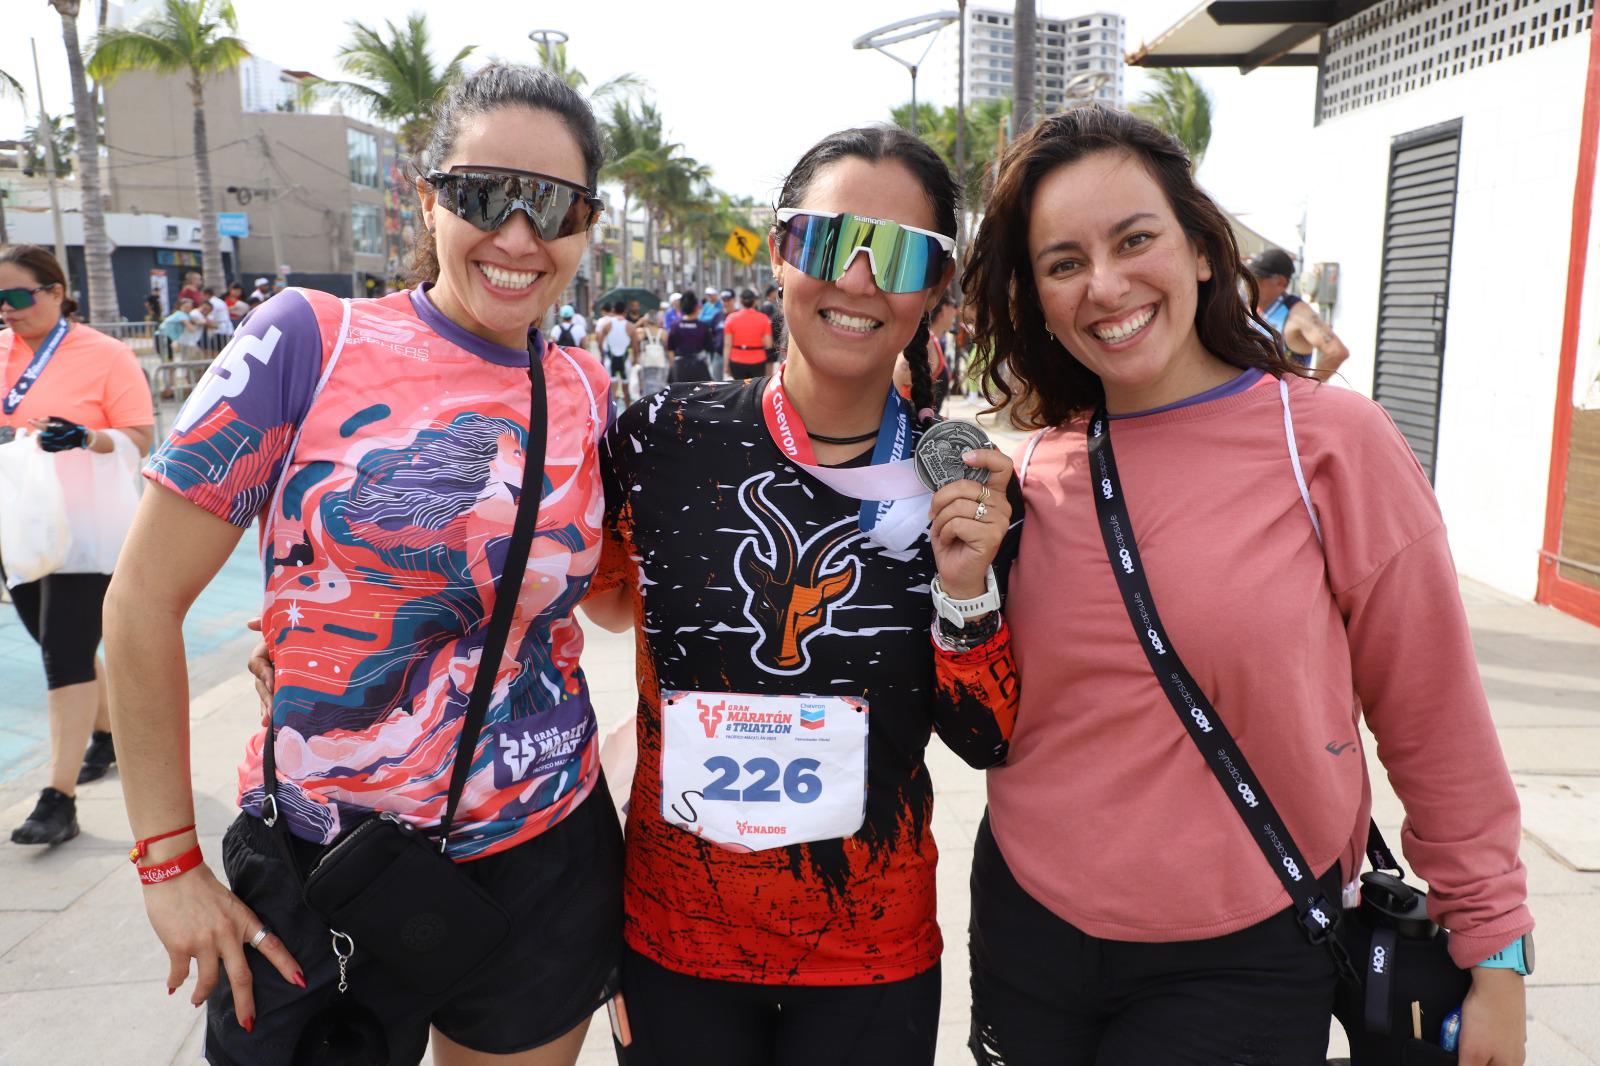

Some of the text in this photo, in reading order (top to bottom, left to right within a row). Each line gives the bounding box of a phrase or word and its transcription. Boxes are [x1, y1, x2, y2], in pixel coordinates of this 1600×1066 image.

[854, 215, 886, 226] SHIMANO
[773, 392, 798, 456] Chevron
[889, 413, 907, 465] RIATLÓN
[727, 711, 793, 724] MARATÓN
[733, 722, 793, 734] TRIATLÓN
[534, 726, 559, 742] GRAN
[703, 755, 823, 804] 226
[1373, 946, 1386, 974] H2O
